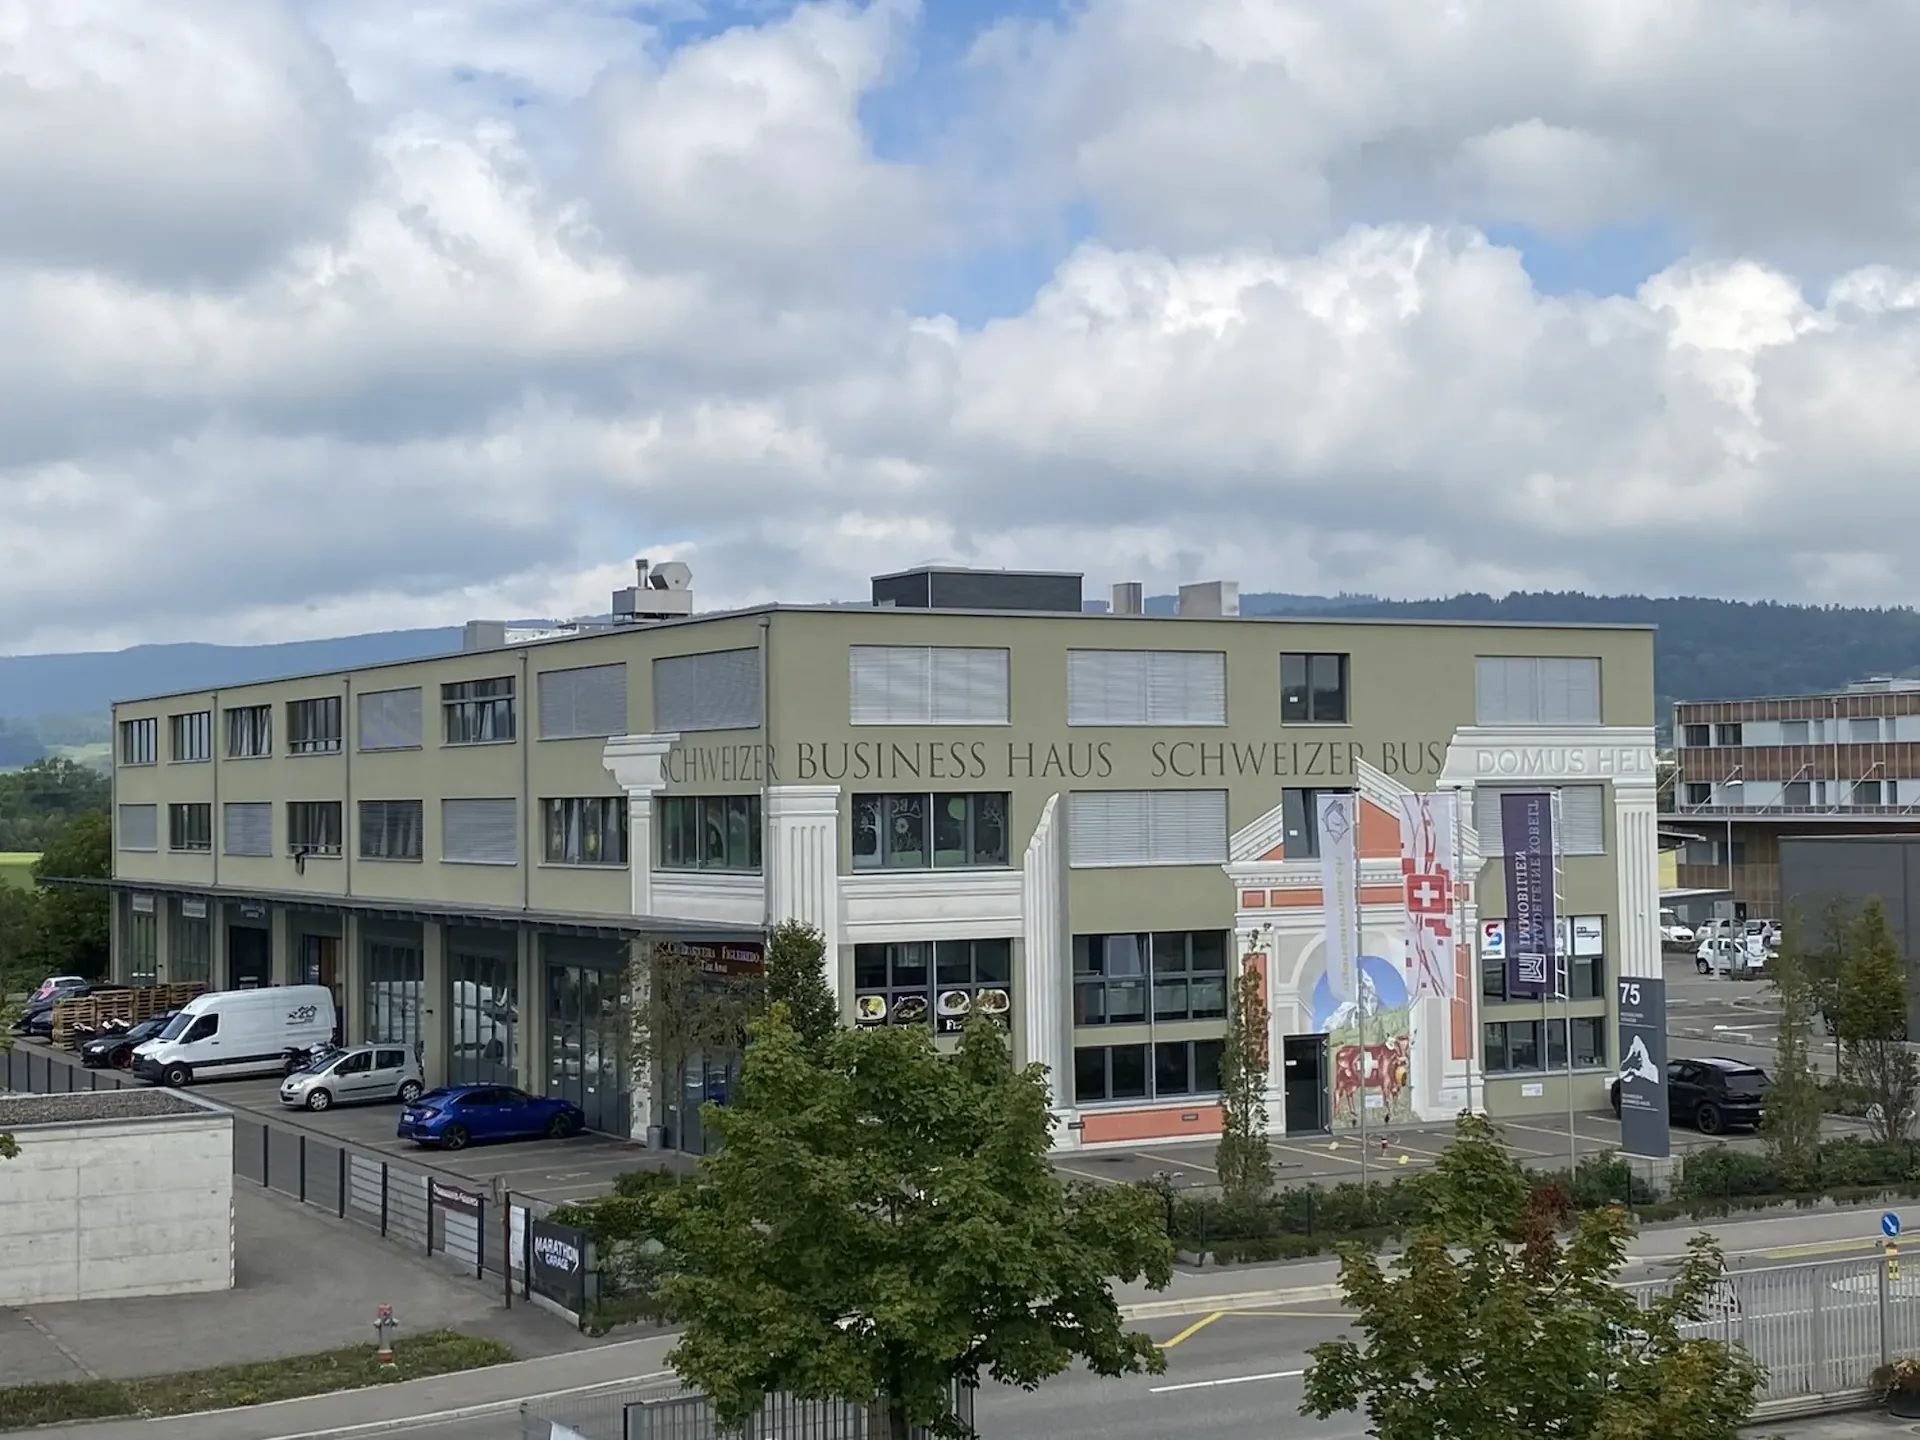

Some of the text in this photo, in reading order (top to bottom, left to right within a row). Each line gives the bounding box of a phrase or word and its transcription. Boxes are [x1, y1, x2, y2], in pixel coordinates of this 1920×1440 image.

[797, 741, 986, 780] BUSINESS
[1007, 741, 1112, 778] HAUS
[1151, 741, 1363, 777] SCHWEIZER
[1382, 741, 1449, 776] BUS
[1475, 748, 1586, 774] DOMUS
[1619, 982, 1641, 1005] 75
[534, 1236, 579, 1264] MARATHON
[545, 1253, 569, 1271] GARAGE
